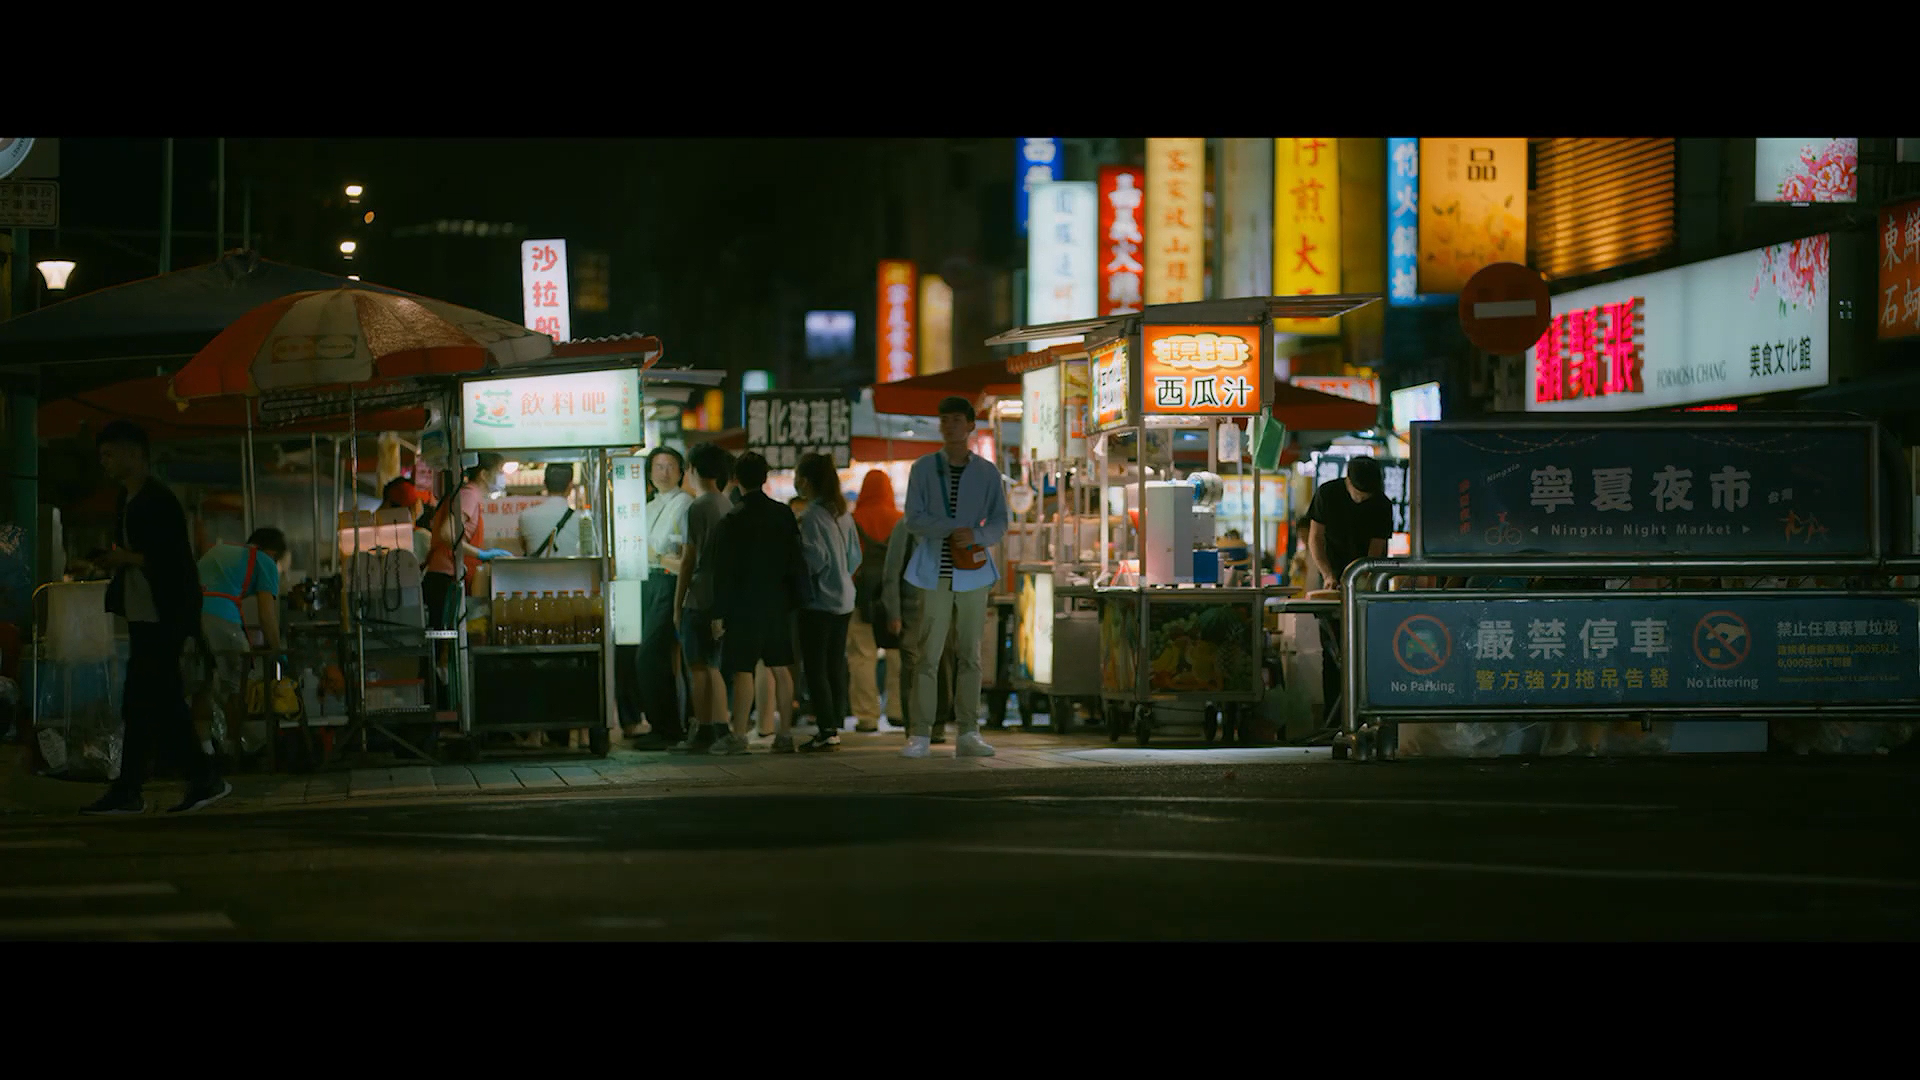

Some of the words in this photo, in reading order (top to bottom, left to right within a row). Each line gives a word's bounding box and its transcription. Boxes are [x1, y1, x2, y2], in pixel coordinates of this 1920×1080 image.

[1749, 336, 1812, 378] 美食文化館
[1697, 361, 1728, 385] CHANG
[520, 391, 606, 416] 飲料吧
[1155, 376, 1253, 407] 西瓜汁
[1530, 464, 1753, 513] 寧夏夜市
[1551, 523, 1614, 539] Ningxia
[1623, 523, 1667, 538] Night
[1676, 523, 1732, 537] Market
[1475, 618, 1670, 661] 嚴禁停車
[1776, 620, 1900, 637] 禁止任意棄置垃圾
[1391, 680, 1407, 693] No
[1410, 680, 1456, 694] Parking
[1475, 667, 1670, 691] 警方強力拖吊告發
[1687, 676, 1704, 689] No
[1706, 676, 1760, 691] Littering
